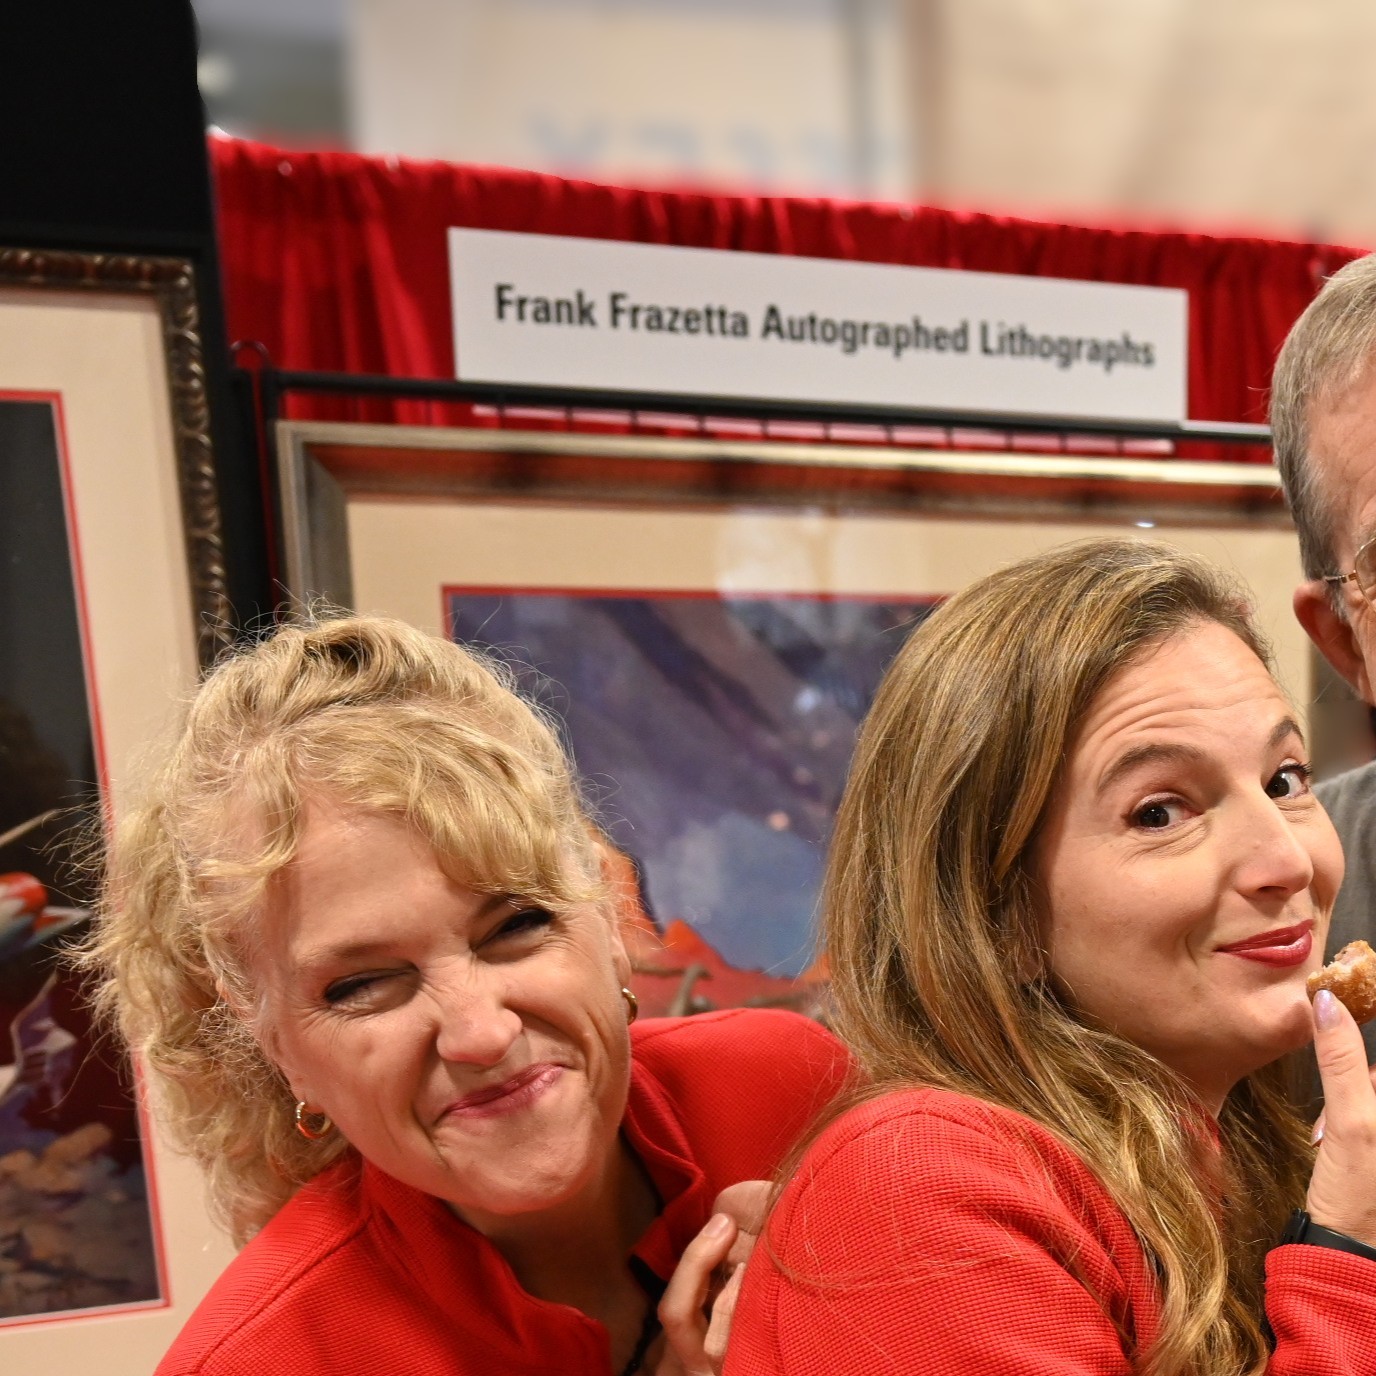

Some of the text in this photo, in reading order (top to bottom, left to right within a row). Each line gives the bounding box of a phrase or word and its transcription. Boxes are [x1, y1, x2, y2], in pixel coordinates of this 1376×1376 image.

[495, 284, 1154, 372] Frank Frazetta Autographed Lithographs
